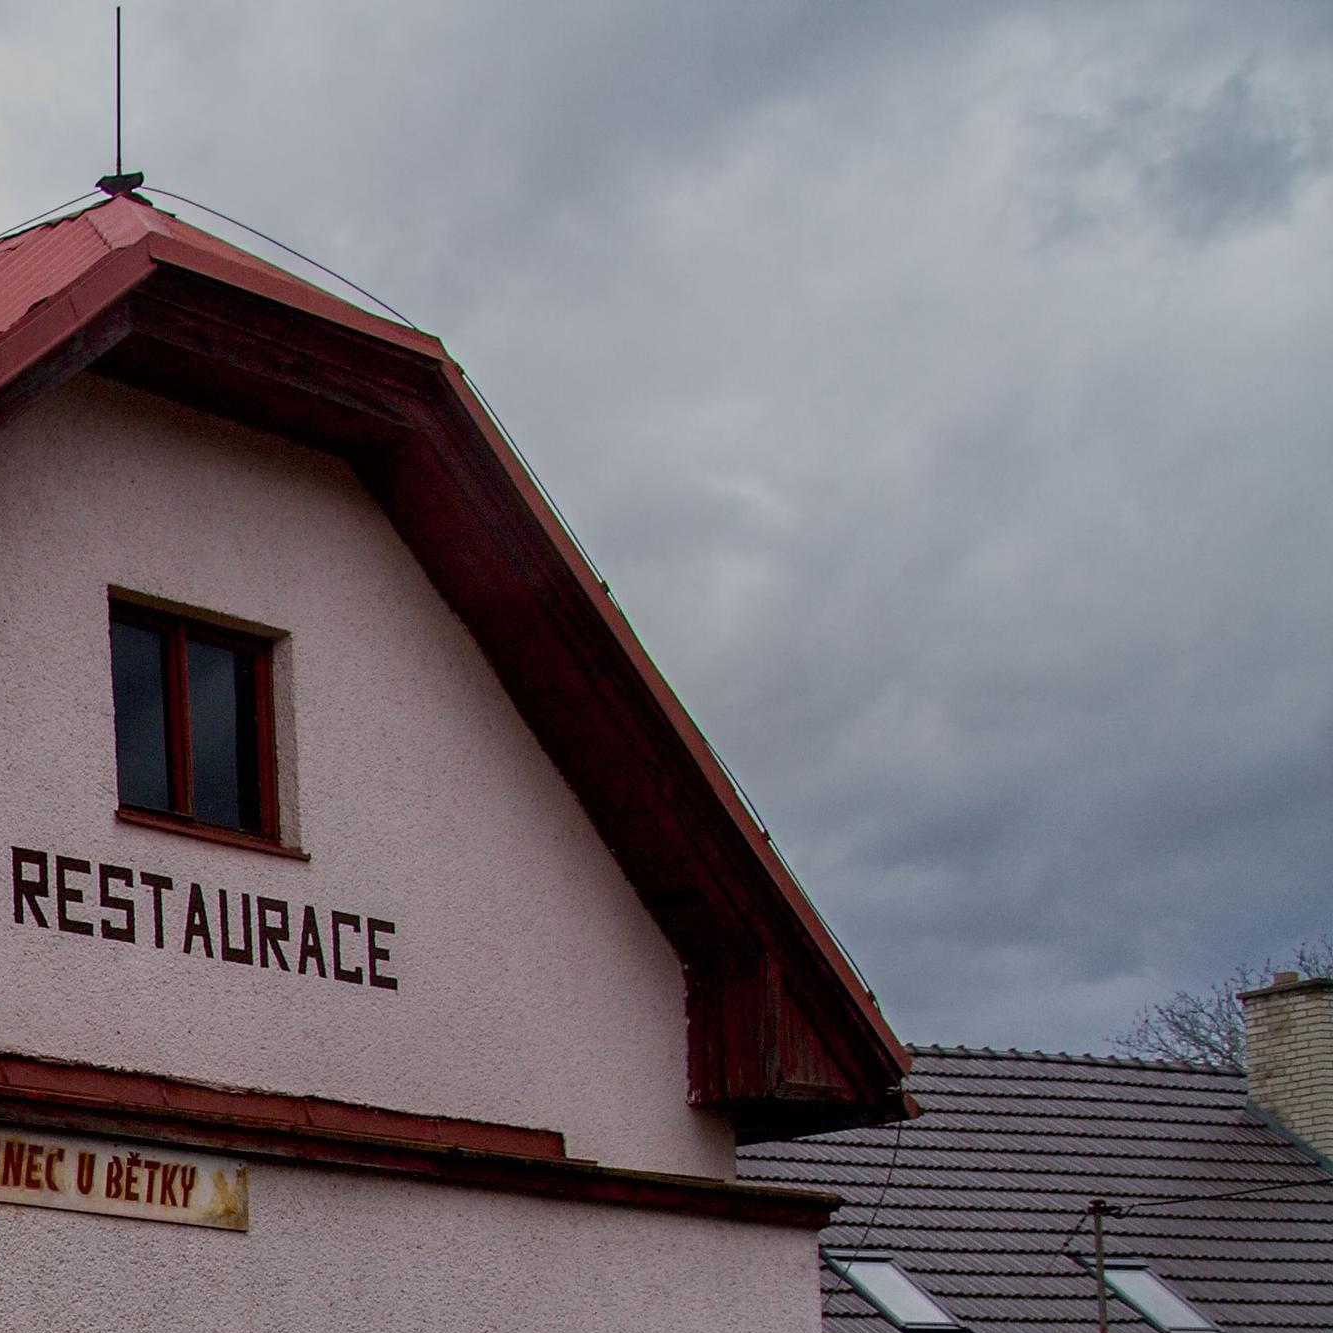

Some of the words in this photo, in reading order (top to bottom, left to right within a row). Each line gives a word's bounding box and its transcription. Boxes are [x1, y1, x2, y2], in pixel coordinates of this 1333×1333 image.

[11, 846, 399, 990] RESTAURACE
[76, 1152, 96, 1196] U
[105, 1151, 197, 1208] BĚTKY
